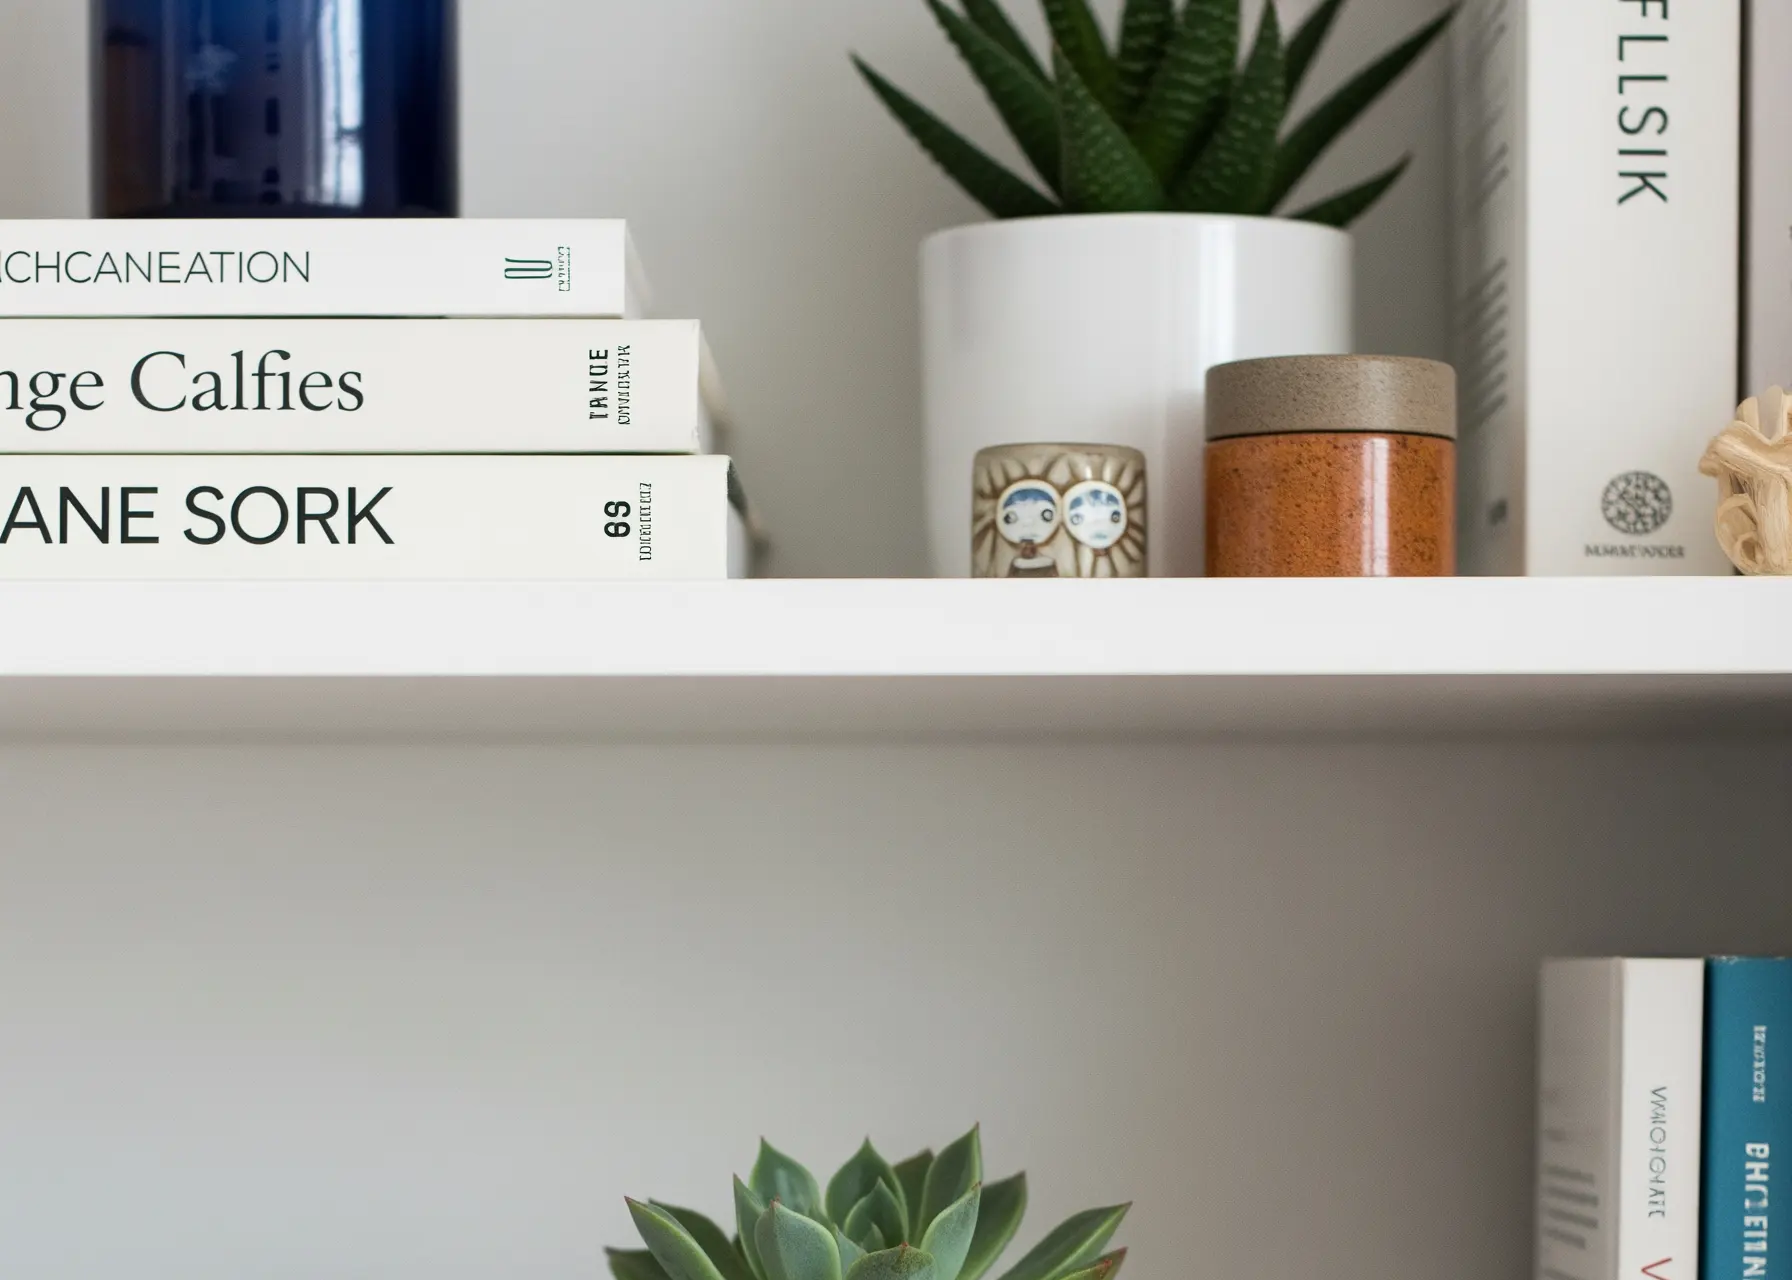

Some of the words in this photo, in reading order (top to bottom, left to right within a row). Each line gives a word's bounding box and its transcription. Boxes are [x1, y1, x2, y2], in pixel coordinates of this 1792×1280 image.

[0, 250, 310, 284] CHCANEATION
[130, 349, 364, 413] Calfies
[0, 486, 160, 545] ANE
[183, 485, 395, 546] SORK
